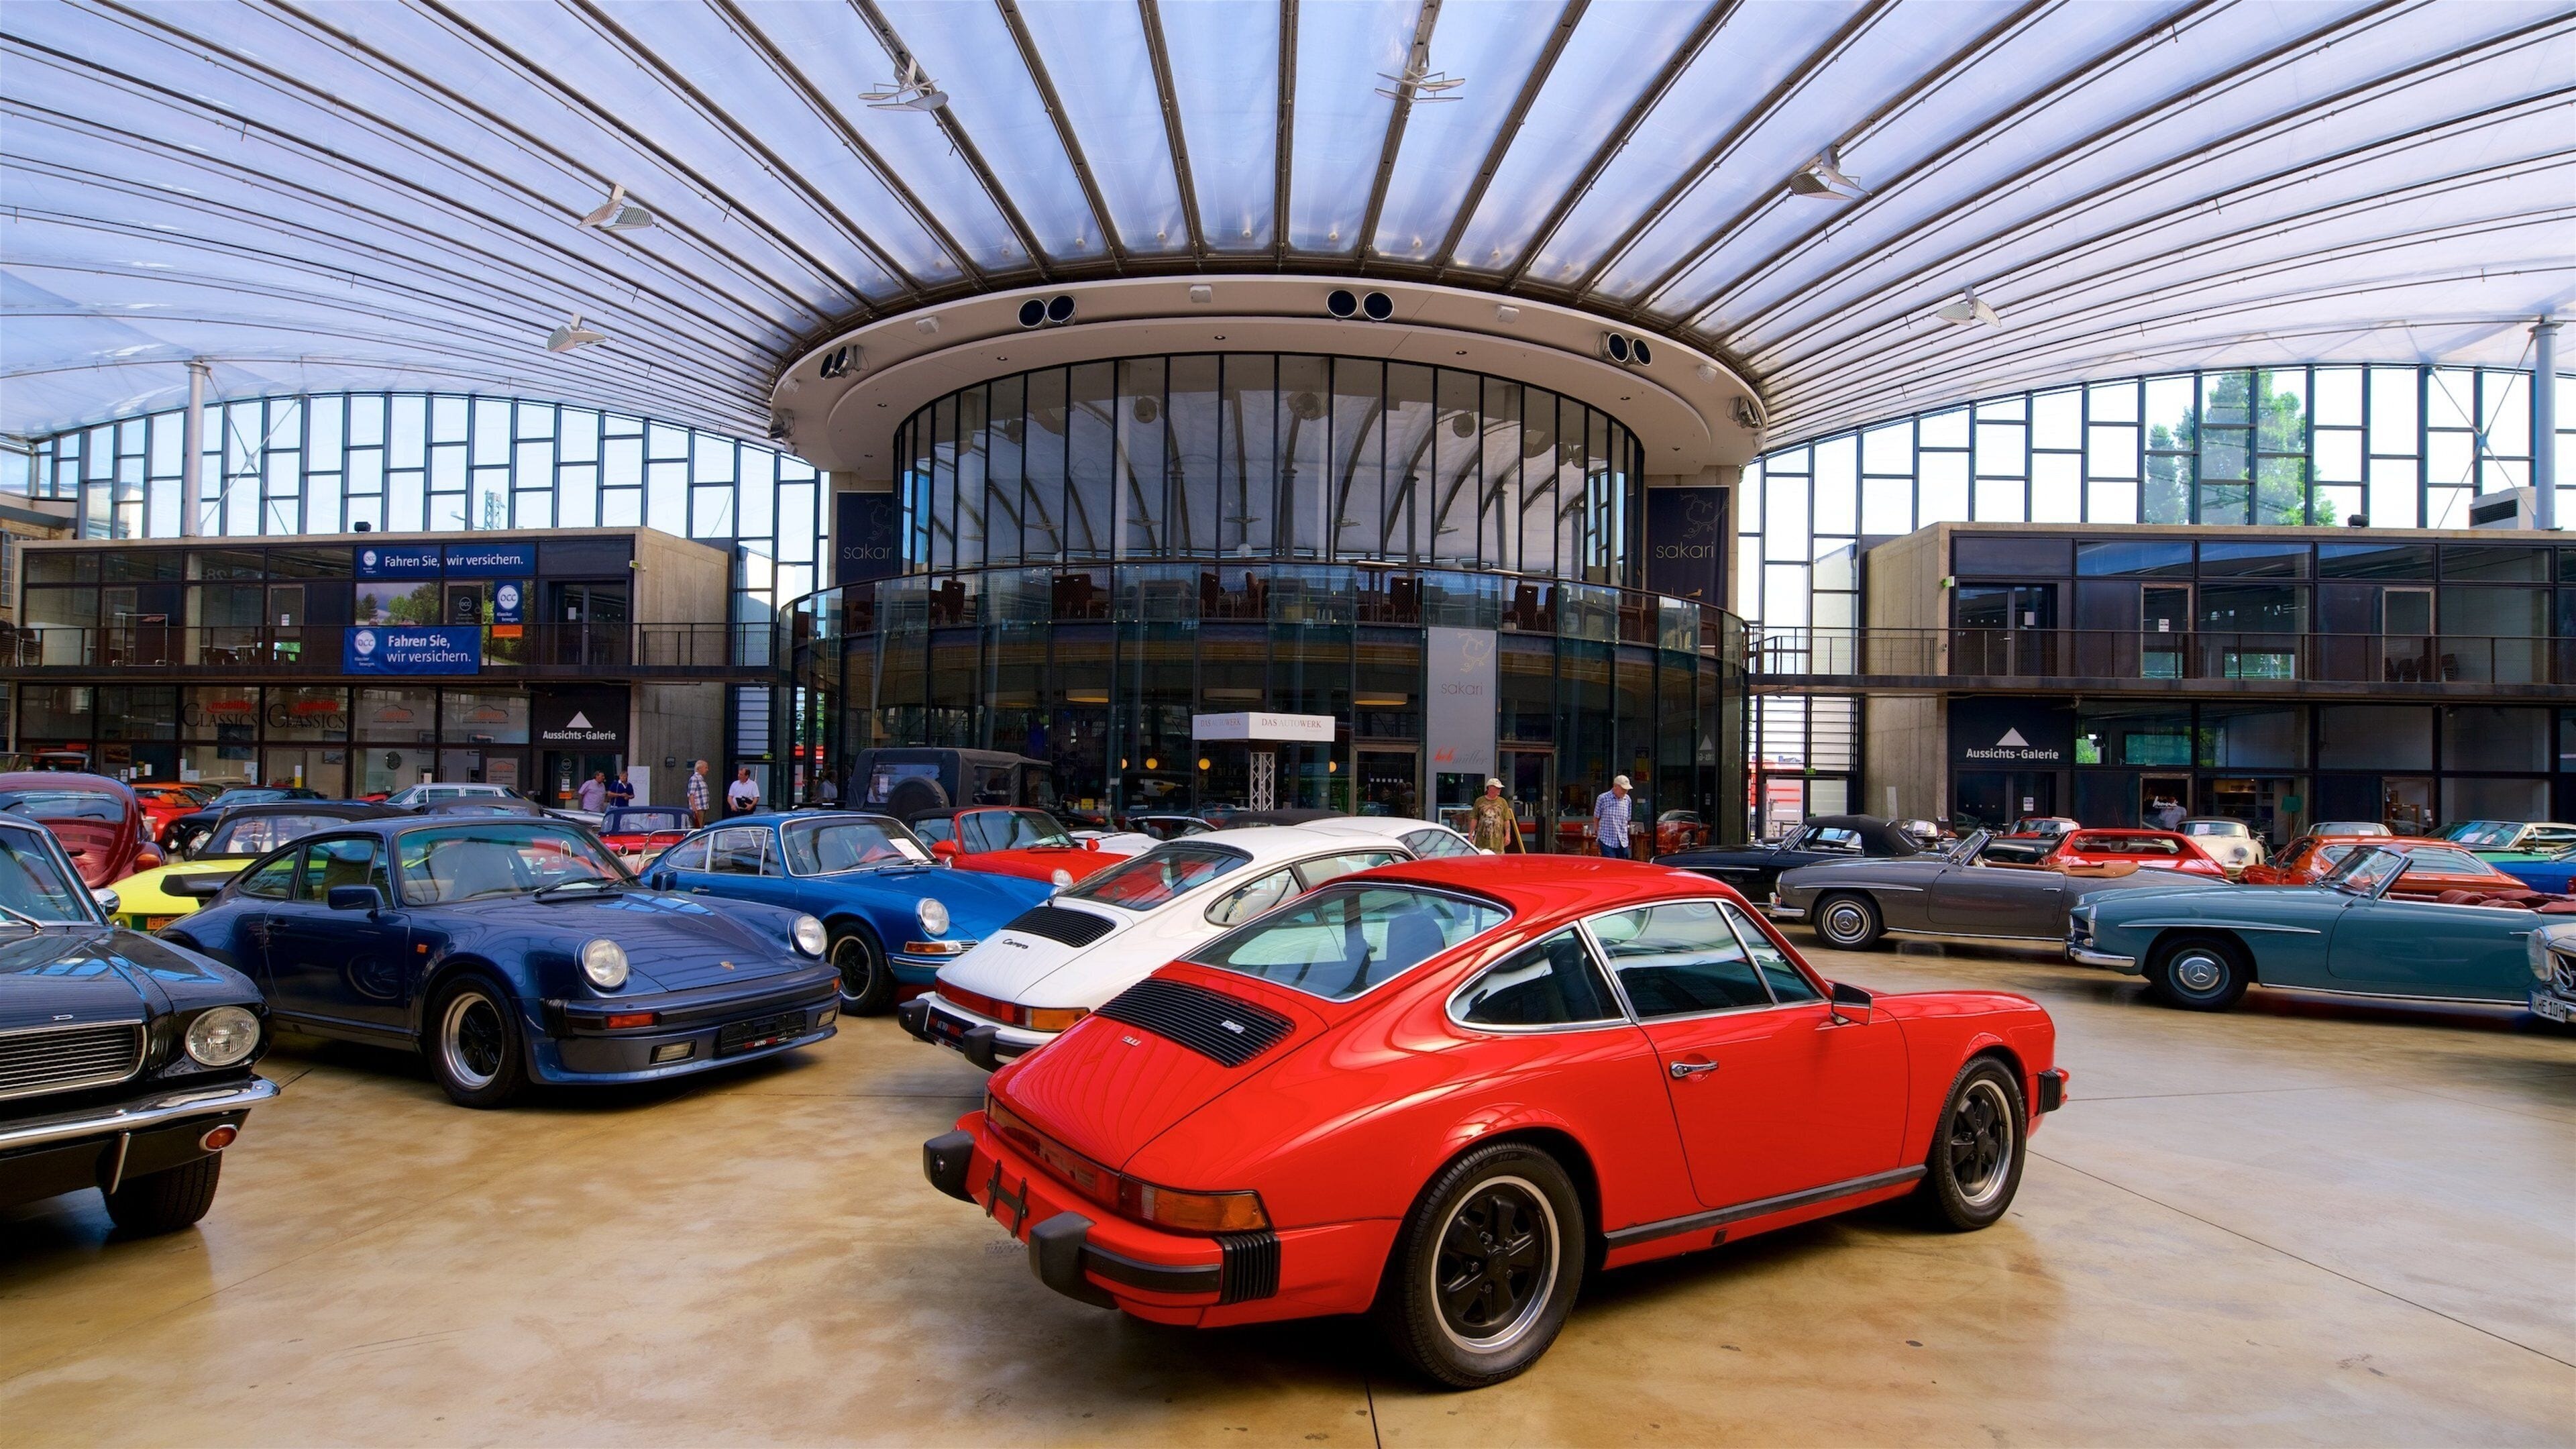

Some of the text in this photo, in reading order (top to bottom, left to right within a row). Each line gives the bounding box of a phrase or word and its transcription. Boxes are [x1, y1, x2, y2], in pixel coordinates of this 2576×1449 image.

[843, 543, 892, 559] sakar
[1656, 541, 1714, 559] sakari
[384, 553, 524, 568] Fahren Sie, wir versichern.
[358, 639, 374, 647] OCC
[388, 635, 450, 649] Fahren Sie,
[387, 650, 472, 663] wir versichern.
[1441, 681, 1483, 695] sakari
[182, 702, 258, 728] CLASSICS
[267, 703, 346, 729] CLASSICS
[1262, 718, 1322, 729] DAS AUTOWERK
[543, 730, 616, 740] Aussichts-Galerie
[1966, 748, 2059, 759] Aussichts-Galerie
